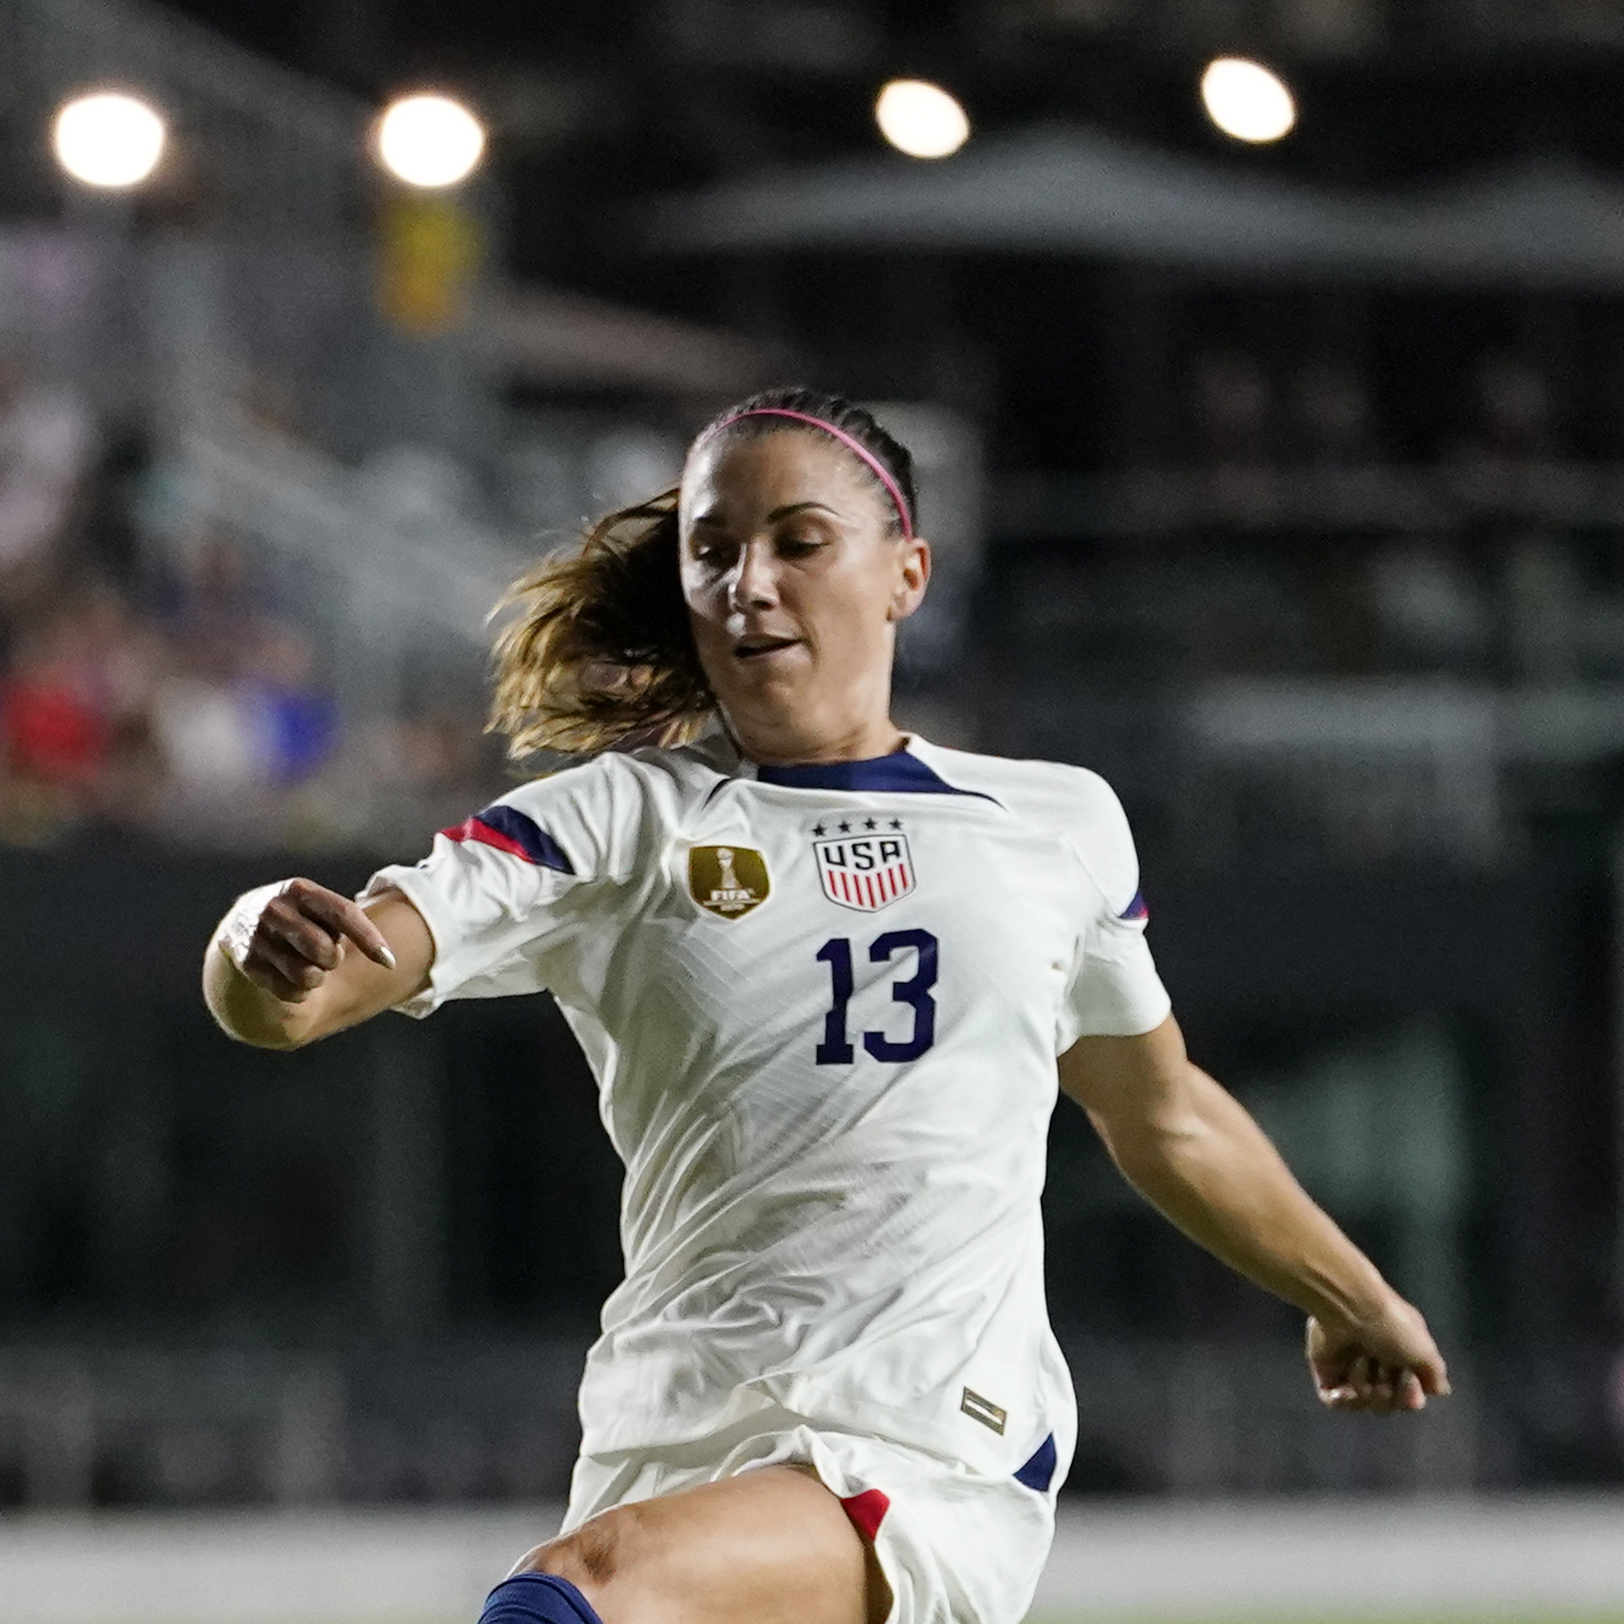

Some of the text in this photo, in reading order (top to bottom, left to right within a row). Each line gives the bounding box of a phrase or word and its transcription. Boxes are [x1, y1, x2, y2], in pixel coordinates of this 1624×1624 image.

[823, 839, 902, 871] USA
[710, 889, 752, 901] FIFA
[815, 928, 939, 1065] 13
